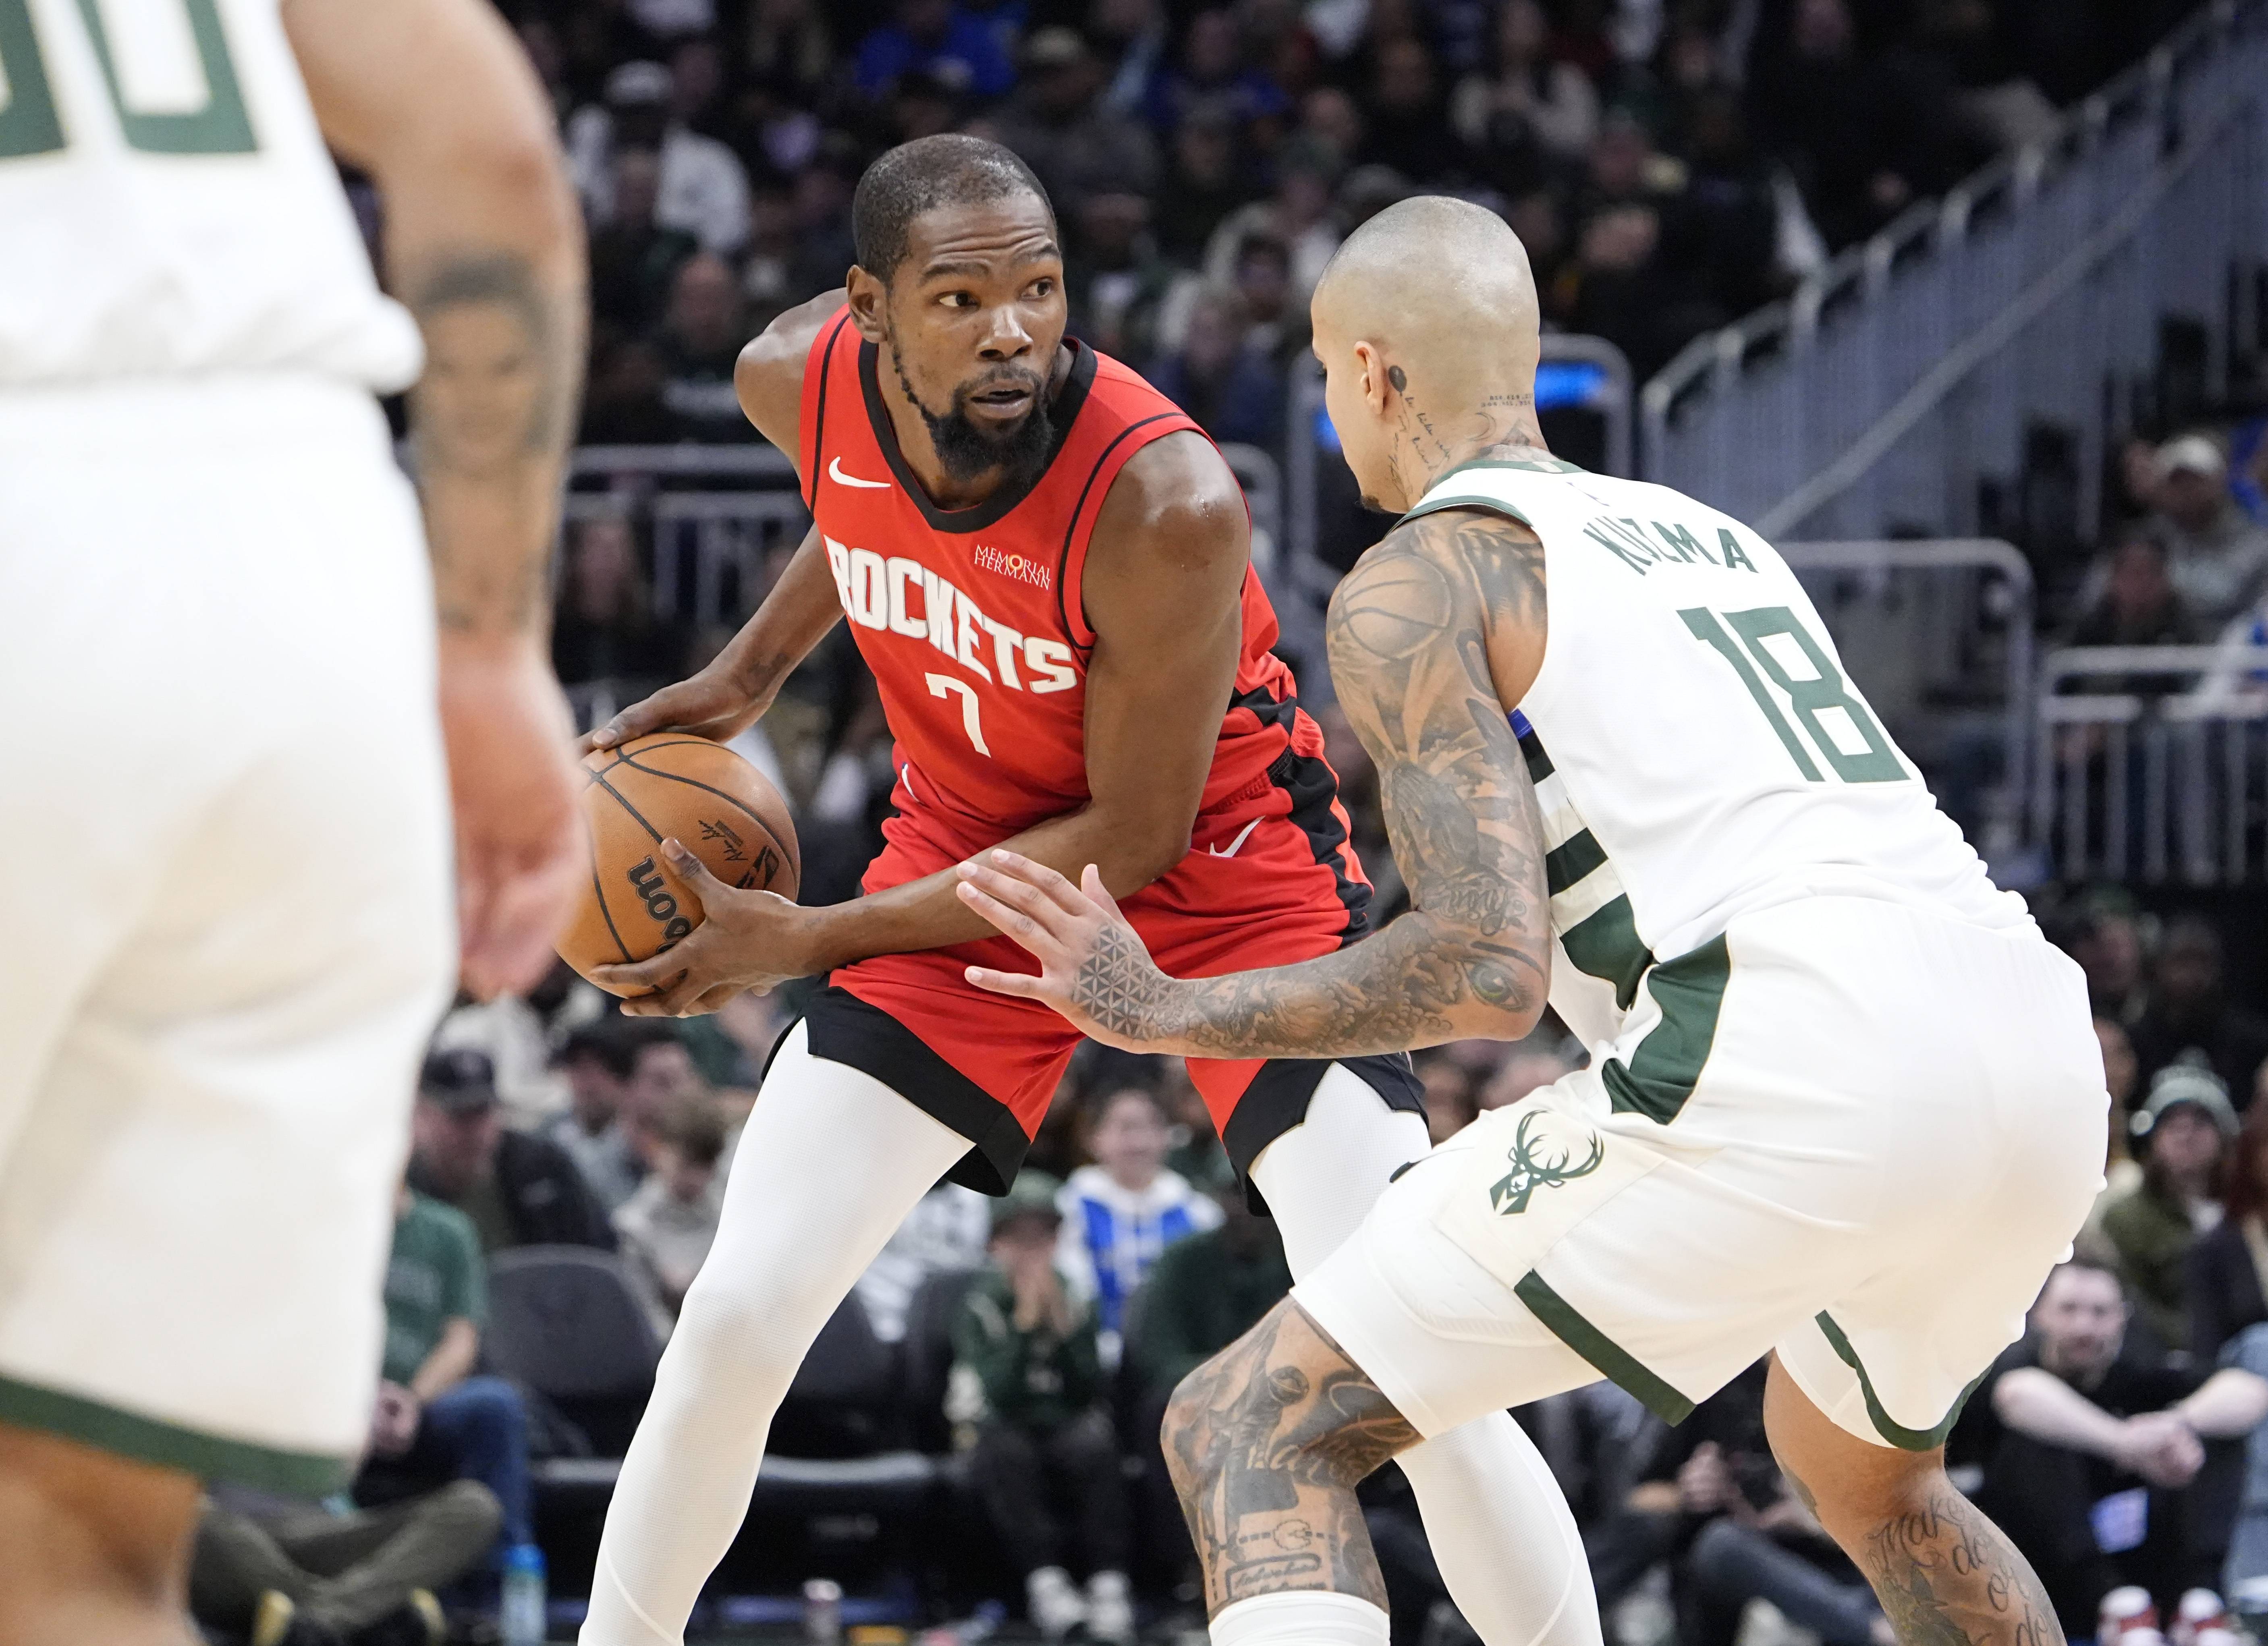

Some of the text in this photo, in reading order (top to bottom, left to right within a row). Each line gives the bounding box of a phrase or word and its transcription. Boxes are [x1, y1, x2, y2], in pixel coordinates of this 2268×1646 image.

[974, 554, 1050, 591] HERMANN
[975, 544, 1051, 581] MEMORIAL
[1583, 516, 1760, 576] KUZMA
[824, 534, 1077, 693] ROCKETS
[924, 672, 991, 758] 7
[1676, 606, 1912, 783] 18
[1864, 1495, 1969, 1572] Make
